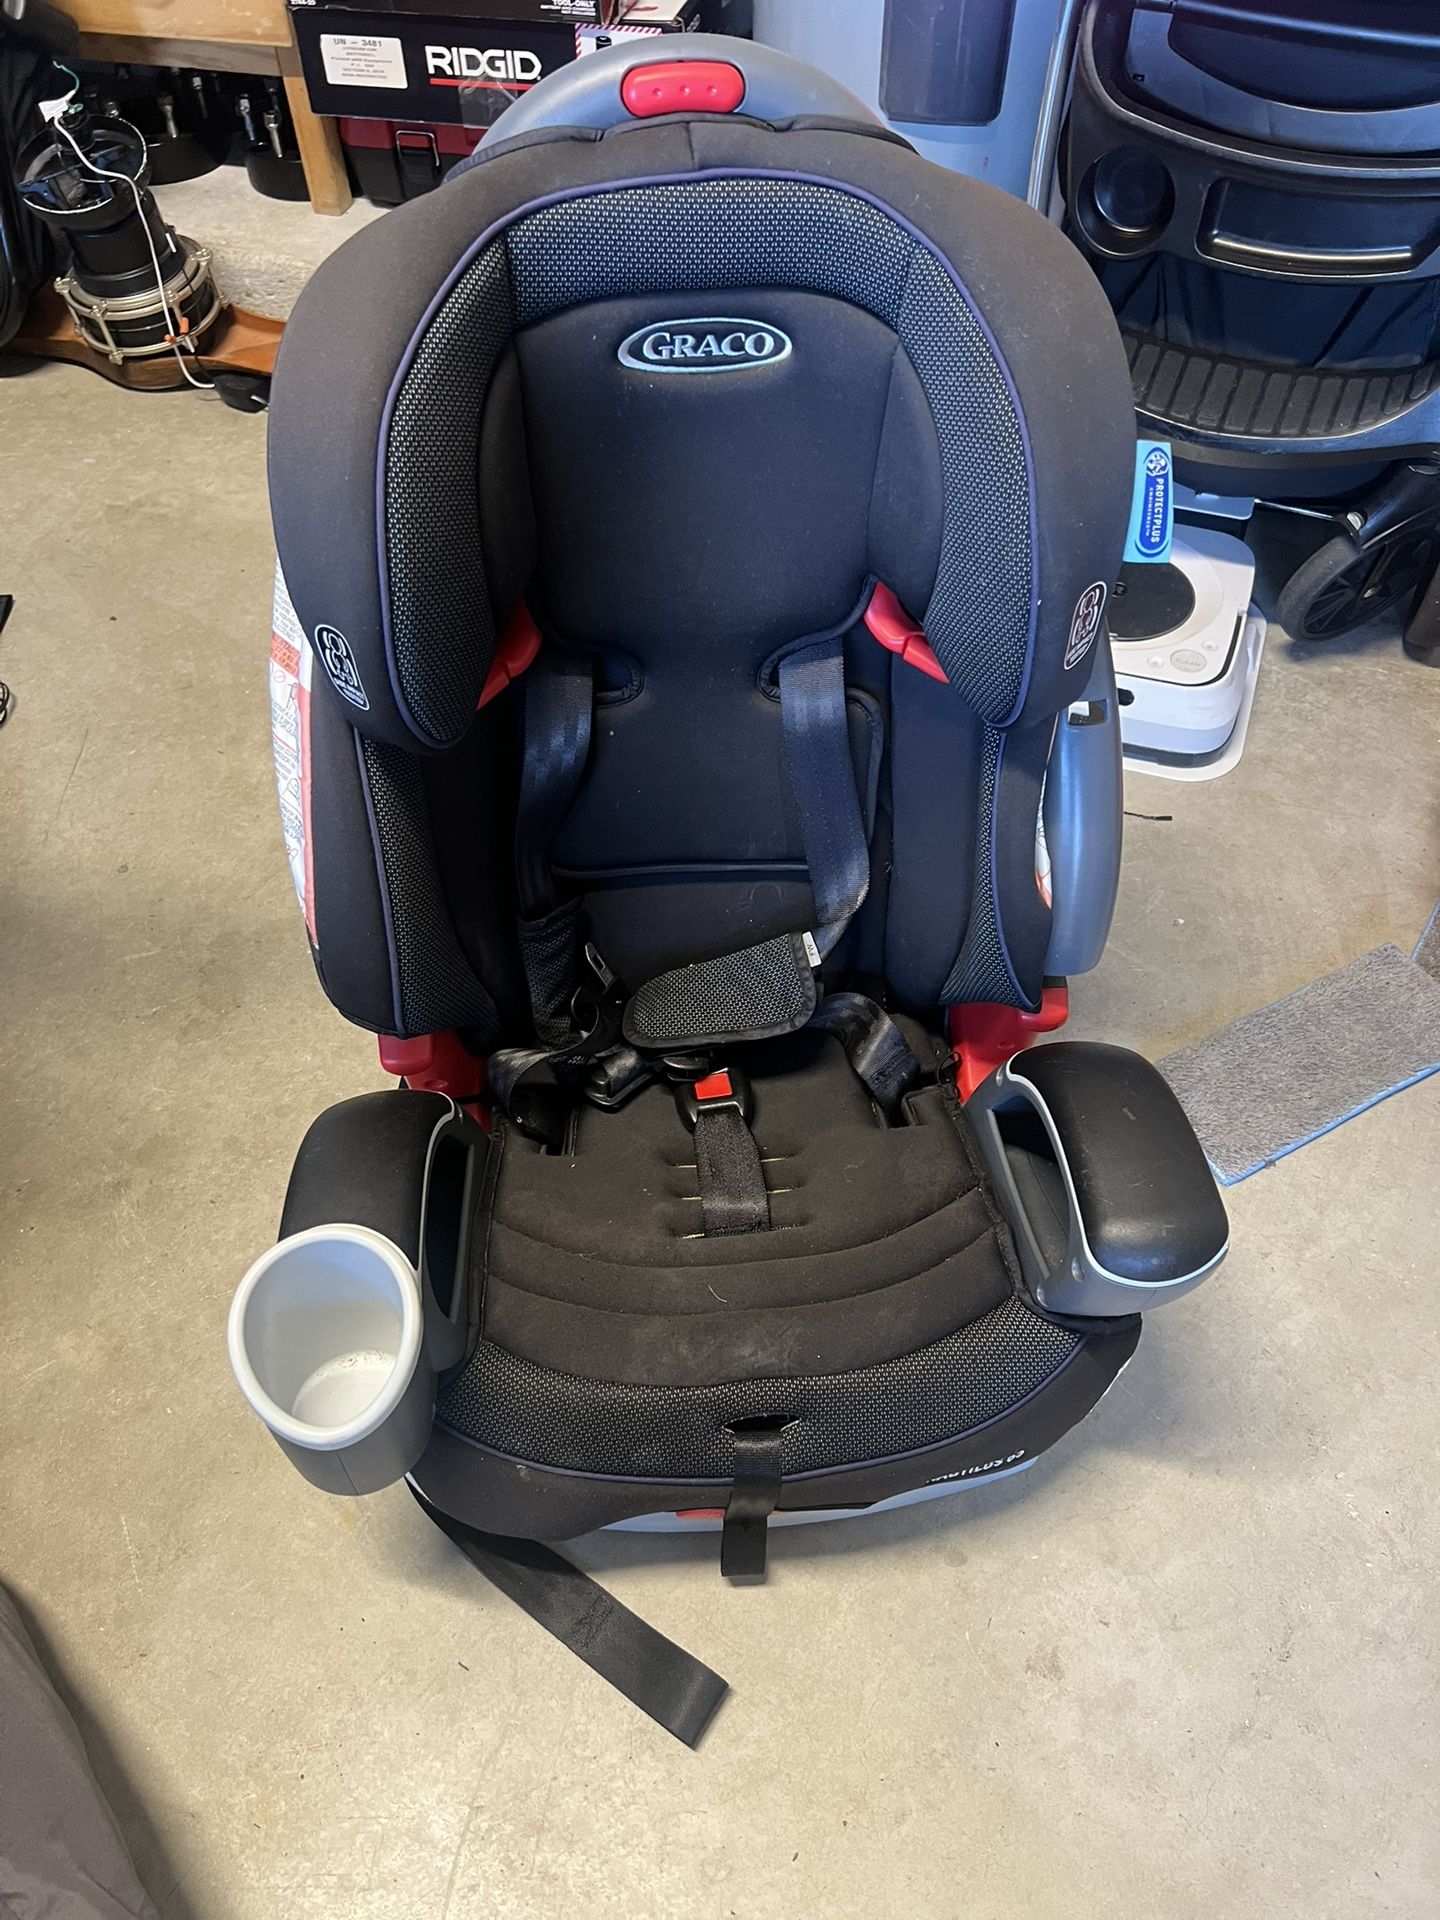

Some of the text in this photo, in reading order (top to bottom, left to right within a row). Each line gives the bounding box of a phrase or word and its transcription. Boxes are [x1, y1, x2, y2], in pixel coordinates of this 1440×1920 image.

[425, 45, 542, 80] RIDGID
[643, 332, 774, 360] GRACO
[1151, 478, 1165, 543] PROTECTPLUS
